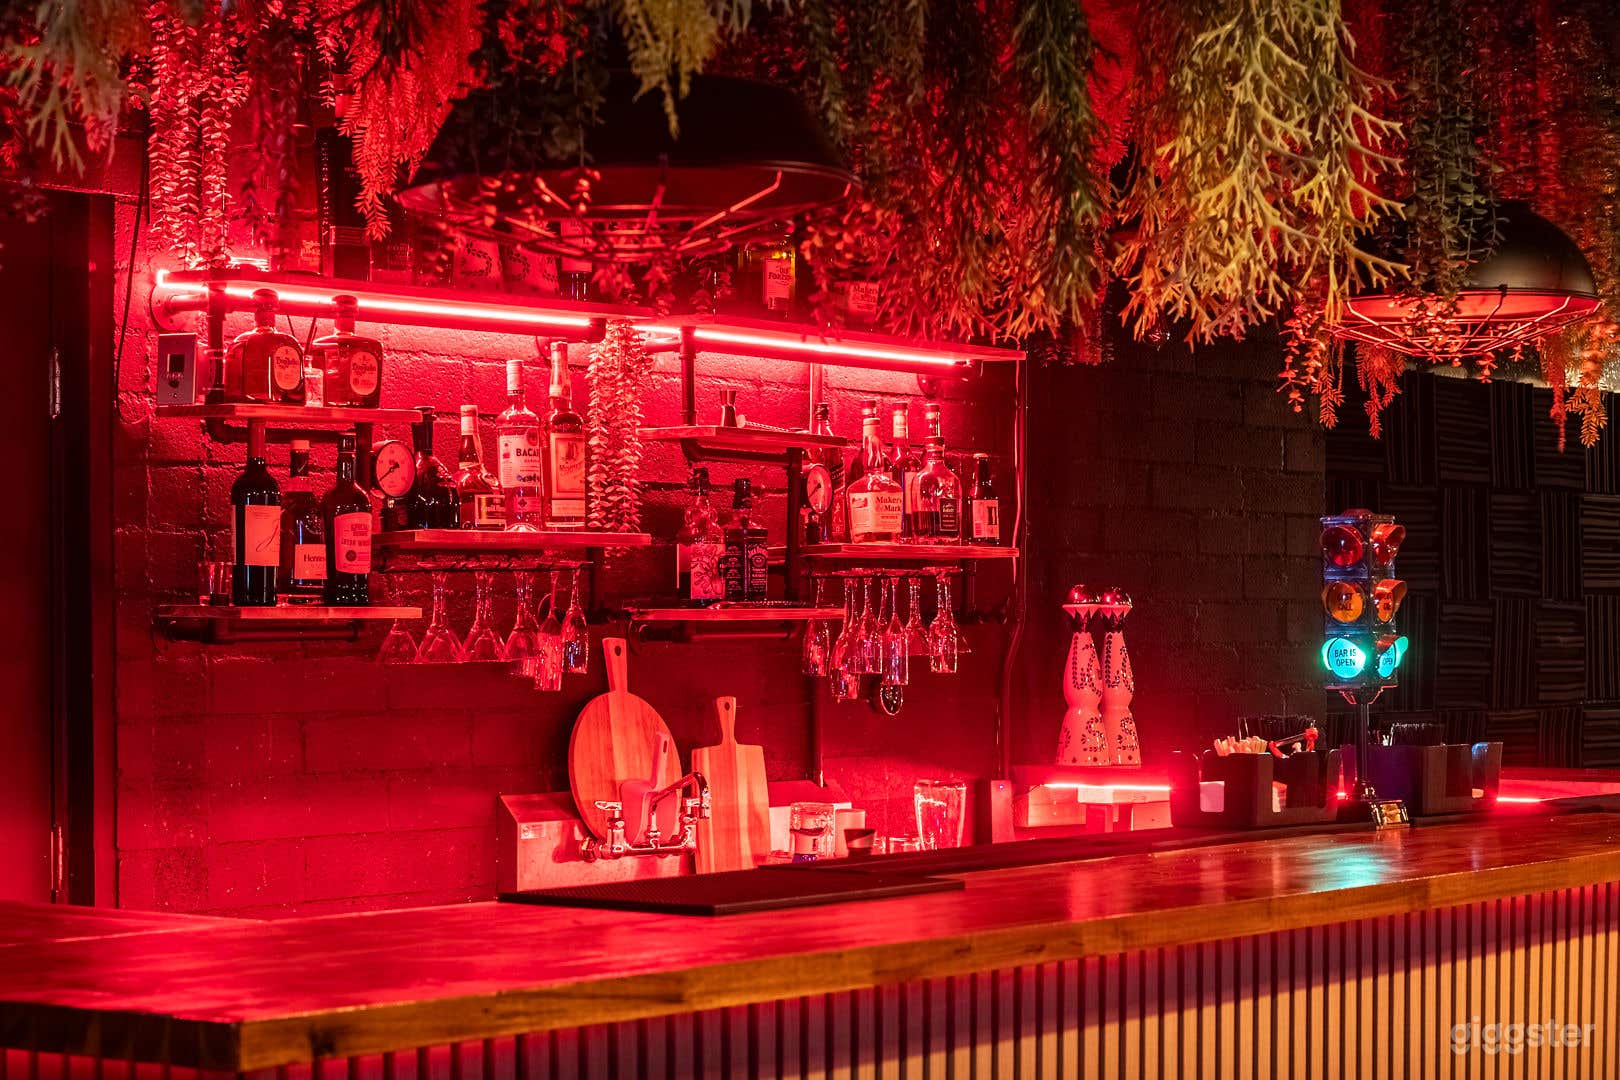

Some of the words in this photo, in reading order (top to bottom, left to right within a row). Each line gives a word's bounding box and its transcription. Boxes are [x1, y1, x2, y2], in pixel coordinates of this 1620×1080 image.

[1334, 649, 1348, 658] BAR
[1349, 649, 1357, 657] IS
[1335, 658, 1356, 666] OPEN
